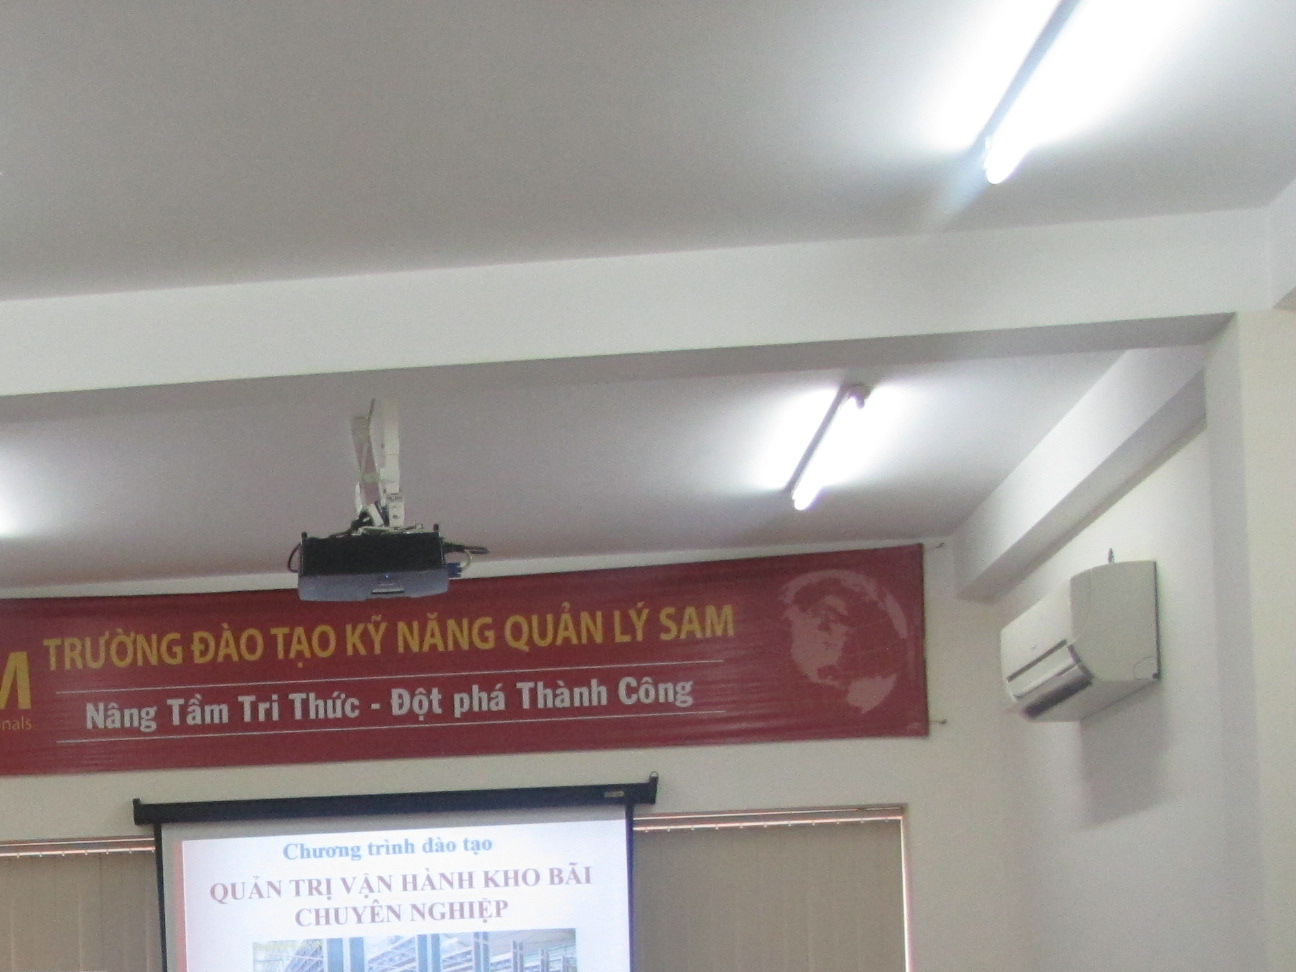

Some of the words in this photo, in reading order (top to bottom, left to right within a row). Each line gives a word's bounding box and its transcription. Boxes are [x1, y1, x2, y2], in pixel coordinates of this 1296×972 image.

[44, 629, 183, 671] TRƯỜNG
[191, 625, 264, 664] ĐÀO
[271, 624, 336, 668] TẠO
[346, 614, 387, 656] KỸ
[396, 613, 496, 654] NĂNG
[505, 602, 603, 653] QUẢN
[614, 601, 650, 643] LÝ
[660, 604, 735, 640] SAM
[86, 700, 157, 733] Nâng
[168, 693, 229, 726] Tầm
[237, 693, 279, 722] Tri
[288, 688, 360, 719] Thức
[391, 688, 442, 721] Đột
[453, 682, 505, 718] phá
[516, 678, 608, 710] Thành
[618, 676, 694, 708] Công
[282, 841, 362, 862] Chương
[367, 838, 415, 857] trình
[421, 836, 457, 854] đào
[462, 836, 493, 856] tạo
[210, 875, 283, 904] QUẢN
[289, 877, 333, 899] TRỊ
[340, 871, 393, 897] VẬN
[401, 866, 475, 892] HÀNH
[482, 867, 541, 888] KHO
[548, 862, 592, 886] BÃI
[295, 900, 402, 927] CHUYÊN
[410, 898, 509, 922] NGHIỆP
